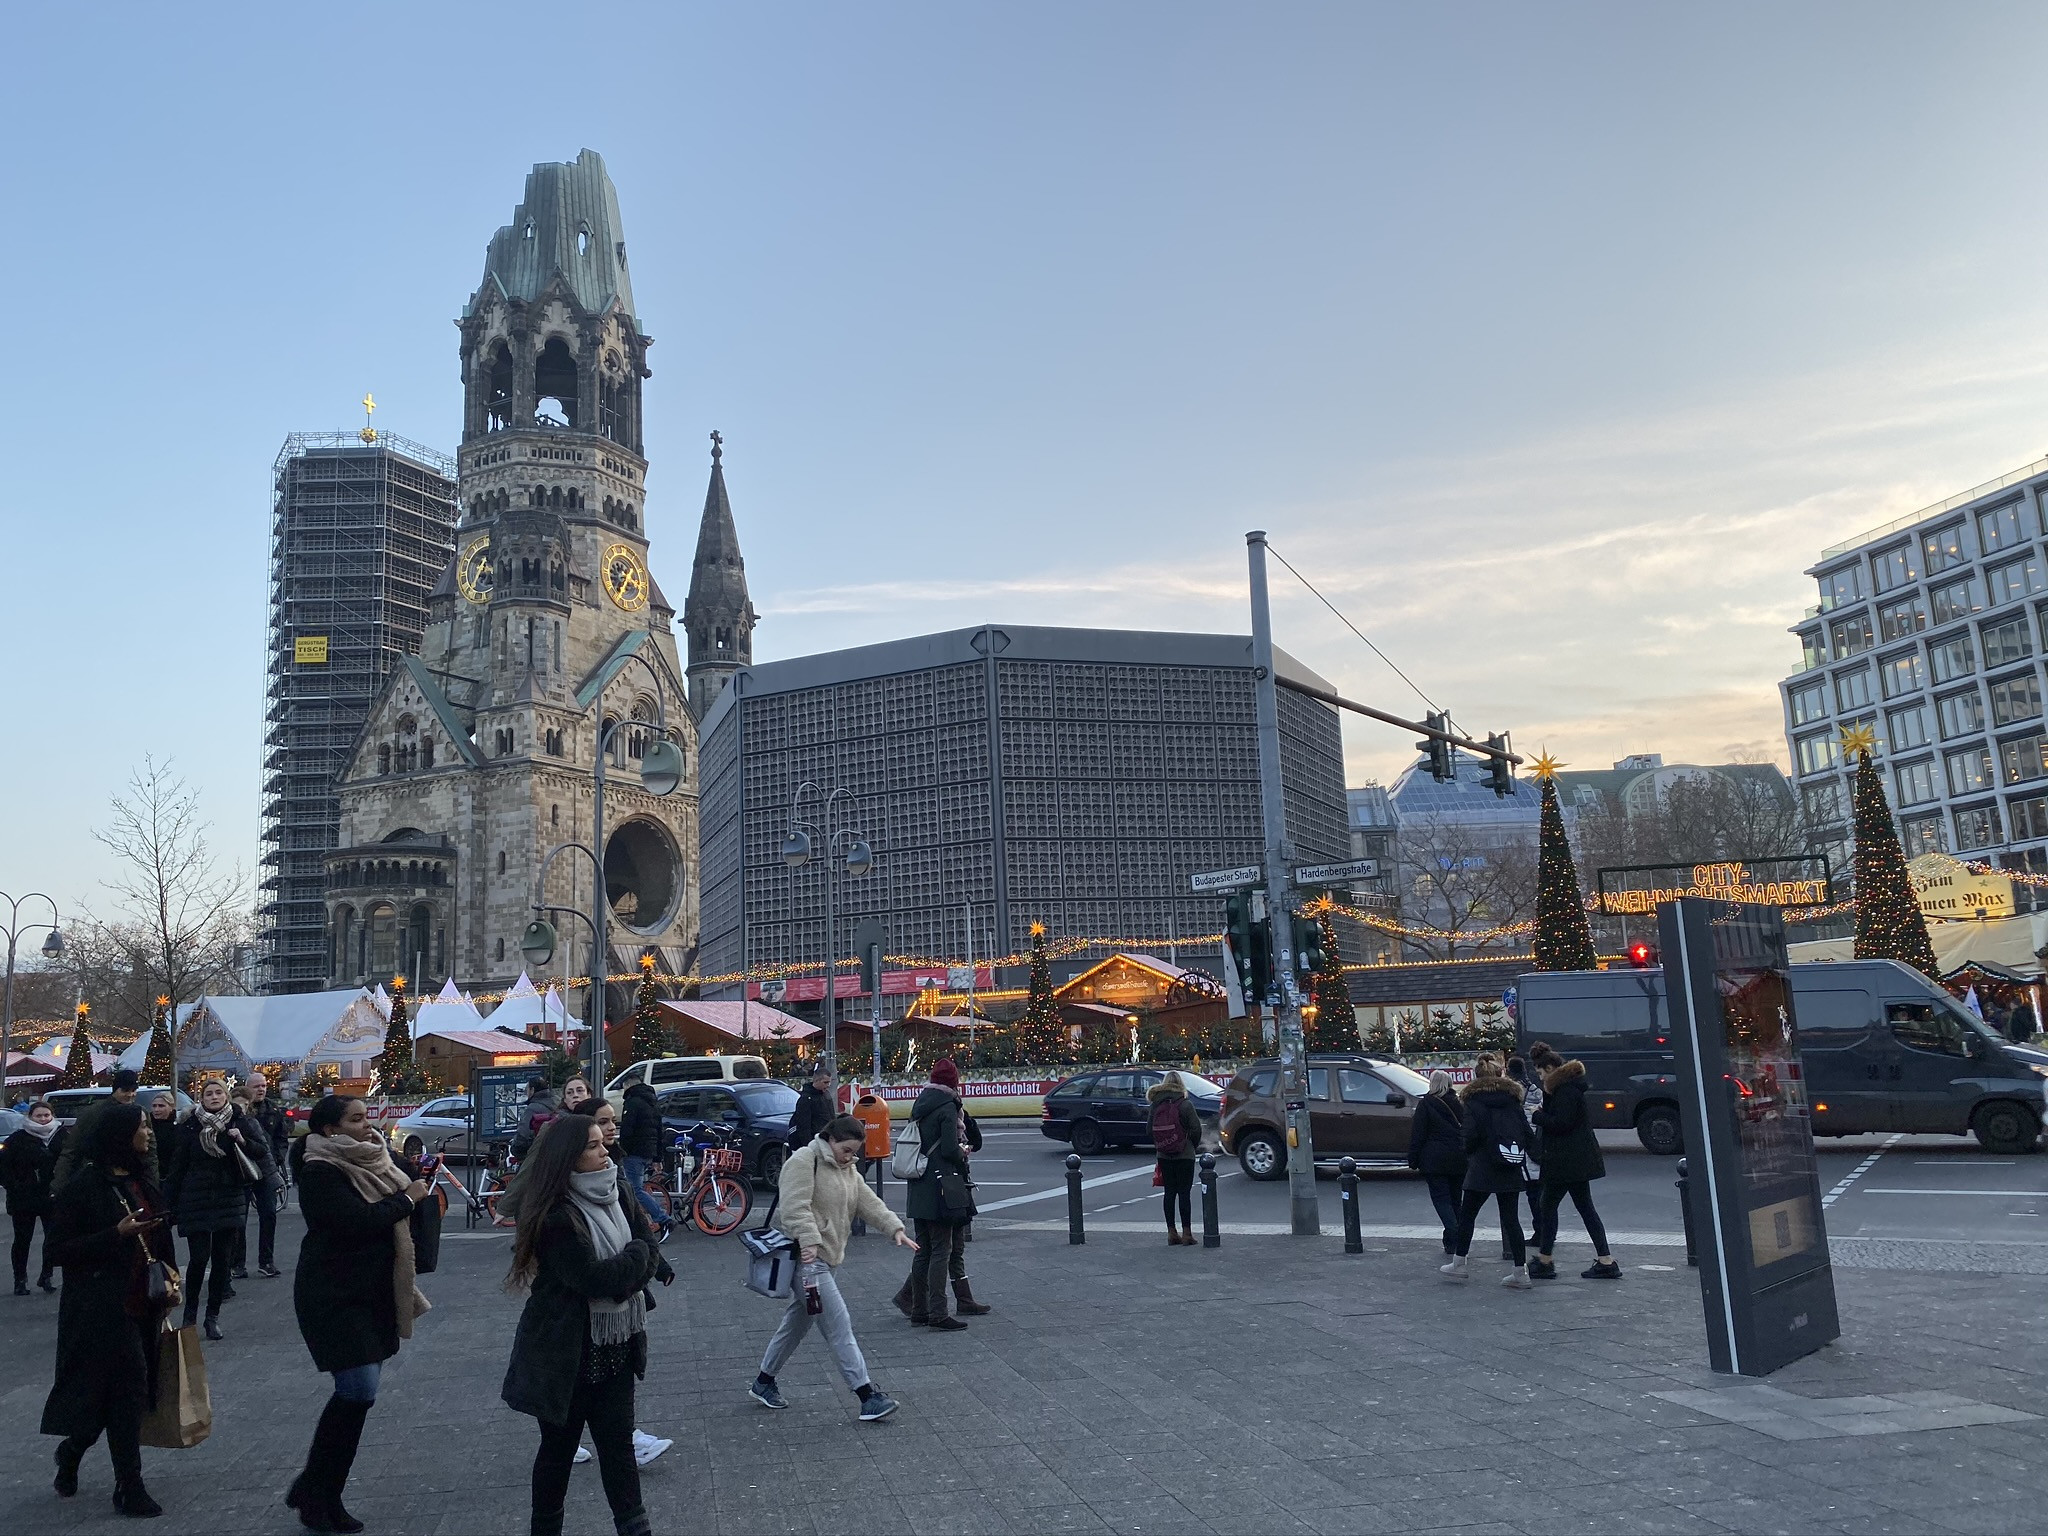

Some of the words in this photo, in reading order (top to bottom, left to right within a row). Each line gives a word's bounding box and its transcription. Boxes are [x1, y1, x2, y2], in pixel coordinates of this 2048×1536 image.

[1195, 873, 1234, 887] Budapester
[1234, 869, 1258, 883] Straße
[1301, 863, 1372, 879] Hardenbergstraße
[1693, 862, 1751, 887] CITY-
[1962, 893, 2004, 907] Max
[870, 1086, 924, 1099] Wihnachts
[964, 1082, 1041, 1096] Breitscheidplatz
